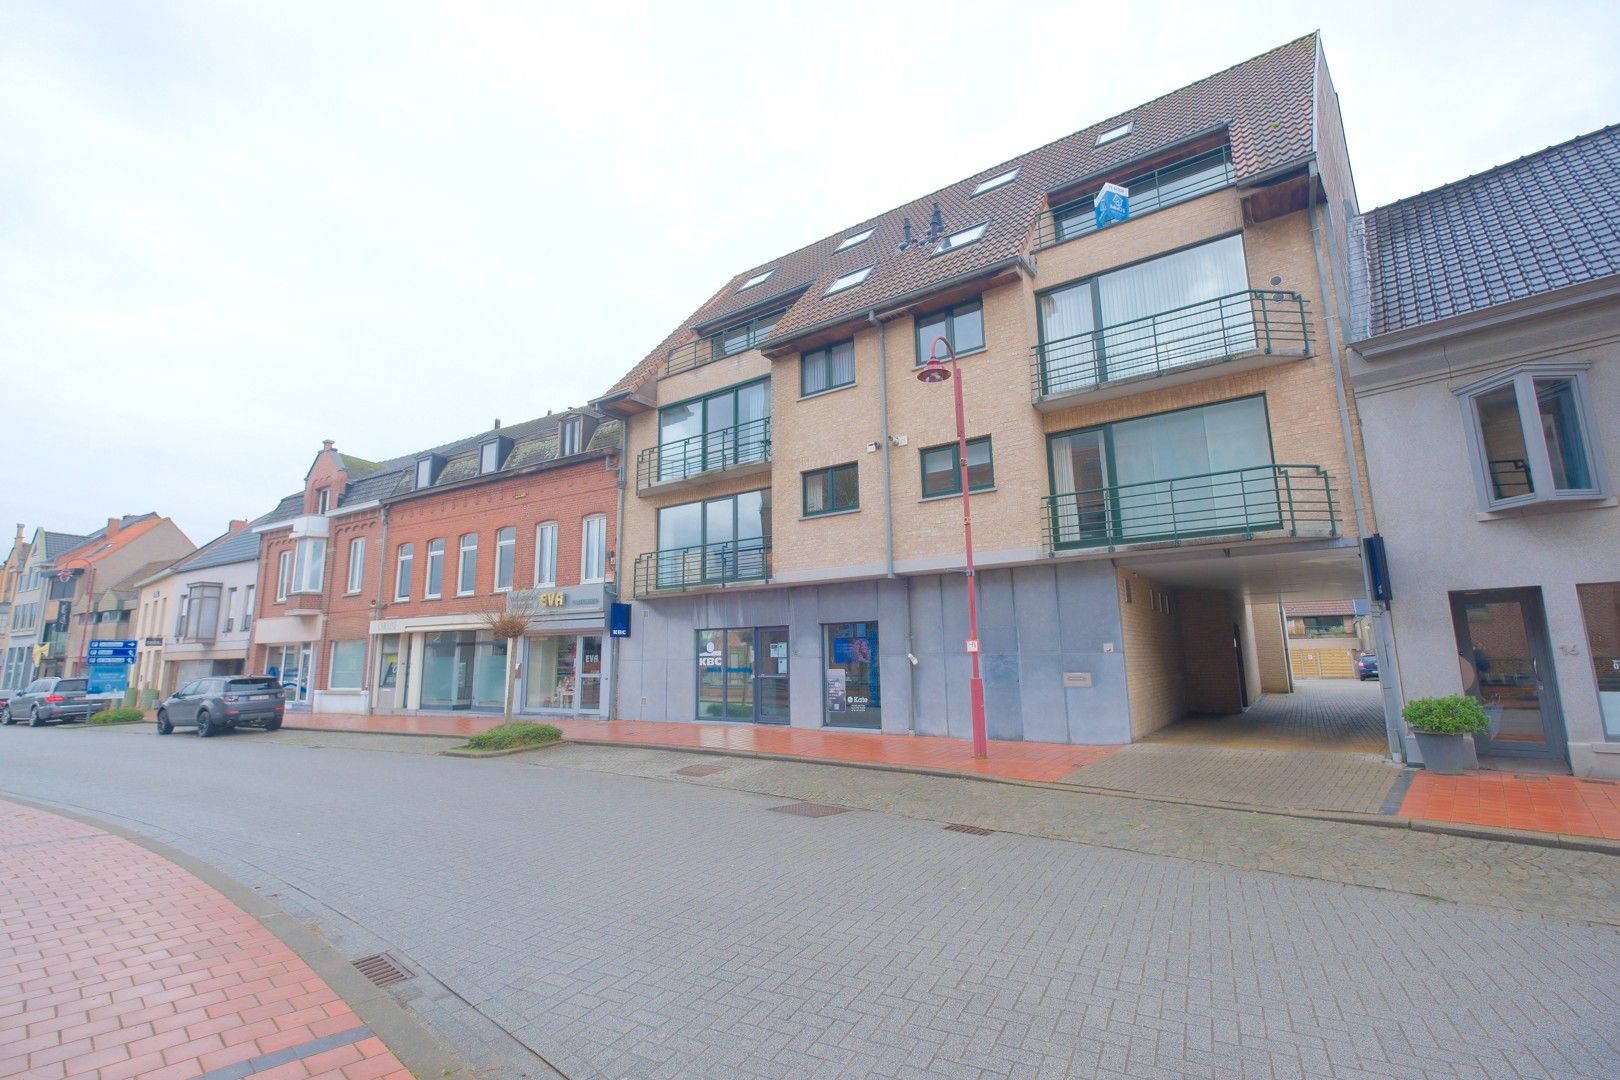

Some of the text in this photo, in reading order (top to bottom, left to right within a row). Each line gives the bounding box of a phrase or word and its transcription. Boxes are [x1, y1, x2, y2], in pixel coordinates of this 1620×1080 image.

[540, 591, 564, 607] EVA
[585, 654, 599, 663] EVA
[699, 657, 722, 666] KBC
